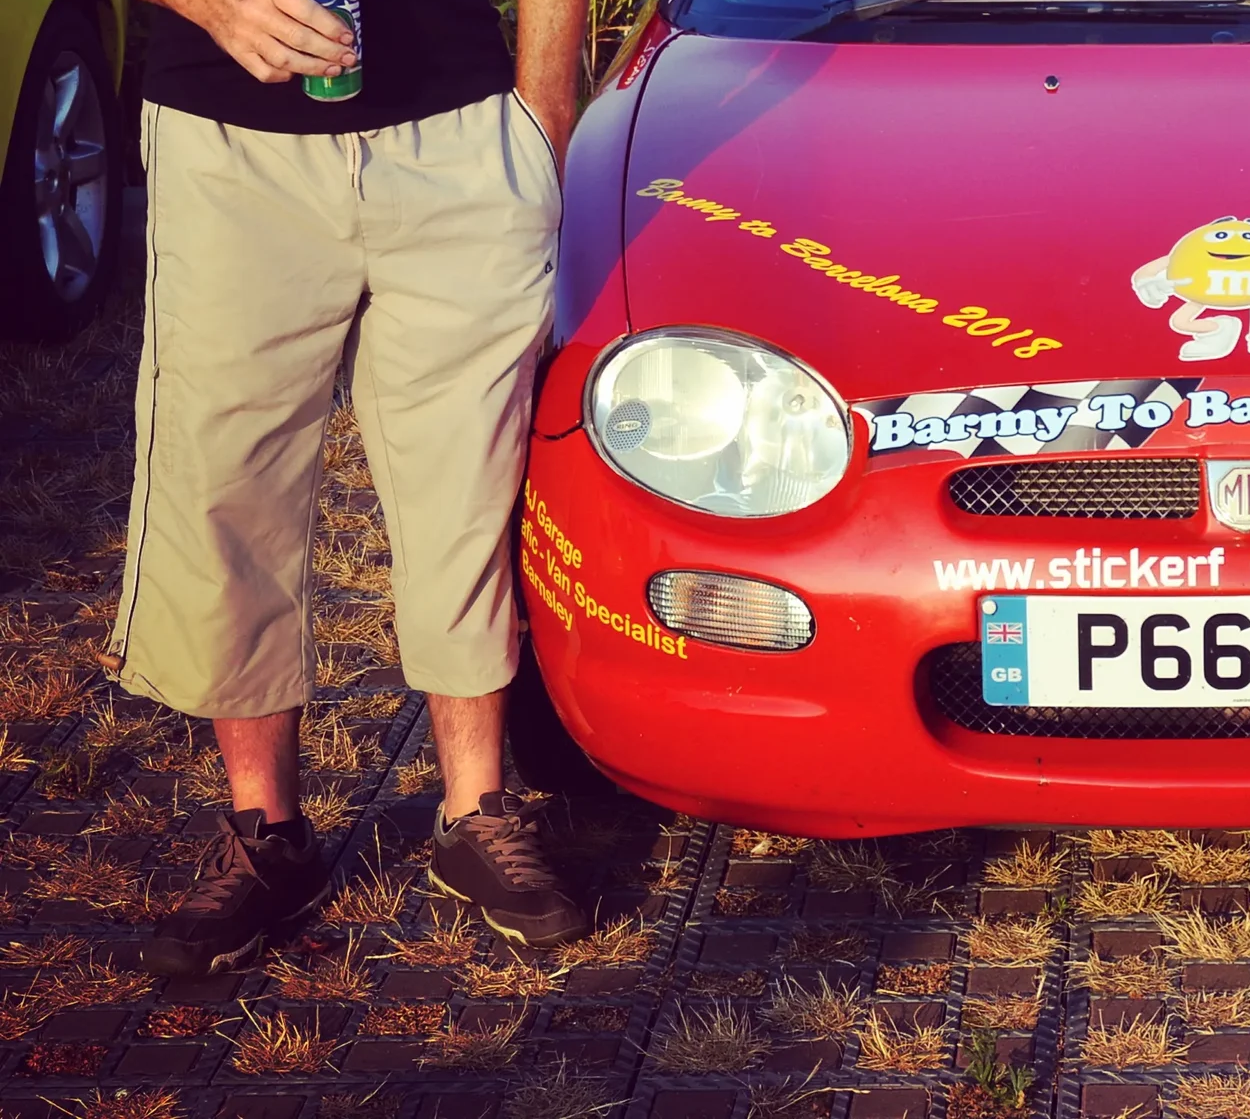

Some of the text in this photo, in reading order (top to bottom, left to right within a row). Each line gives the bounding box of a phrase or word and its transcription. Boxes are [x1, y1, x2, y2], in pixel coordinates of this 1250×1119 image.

[636, 177, 1063, 359] Barmy to Barcelona 2018
[872, 404, 1078, 452] Barmy
[1088, 392, 1174, 432] To
[537, 500, 583, 569] Garage
[522, 547, 573, 632] Barnsley
[546, 548, 571, 596] Van
[573, 581, 688, 660] Specialist
[990, 667, 1023, 683] GB
